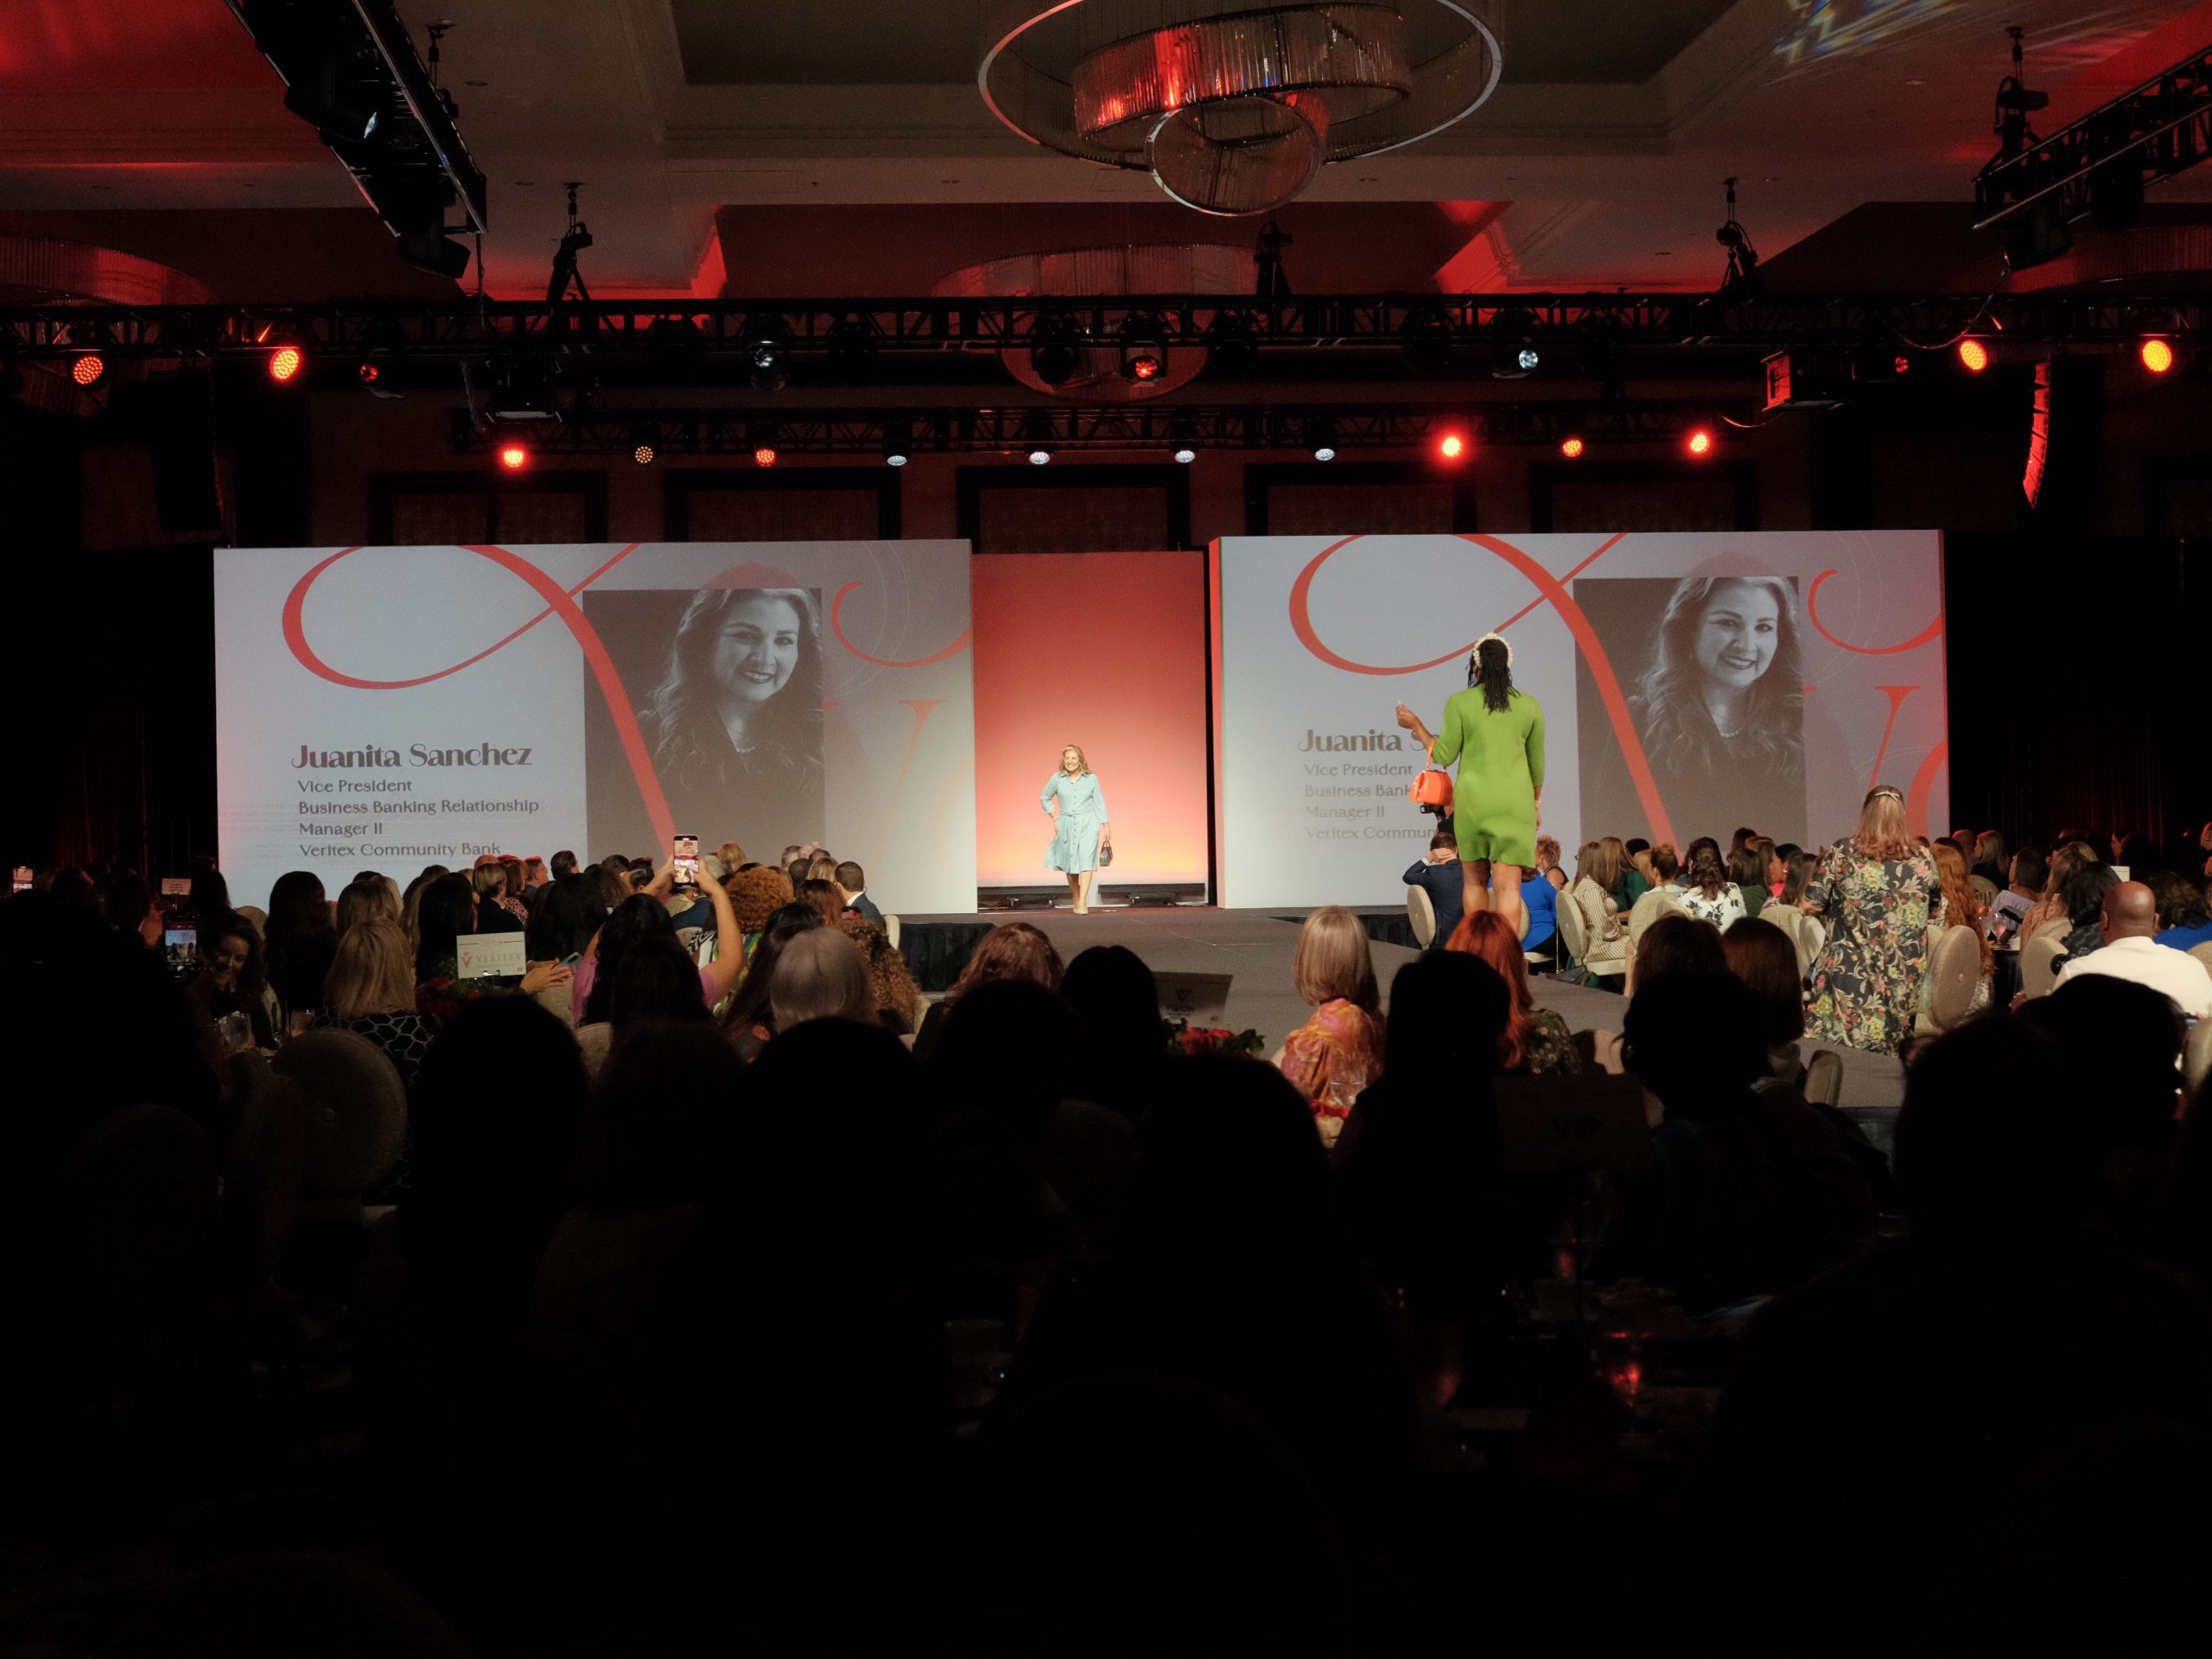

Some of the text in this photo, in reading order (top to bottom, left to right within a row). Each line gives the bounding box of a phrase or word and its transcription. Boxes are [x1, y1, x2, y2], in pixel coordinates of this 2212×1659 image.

[1298, 728, 1403, 752] Juanita
[291, 742, 532, 768] Juanita Sanchez
[1304, 764, 1413, 776] Vice President
[298, 779, 413, 792] Vice President
[1306, 785, 1410, 797] Business Bank
[299, 799, 539, 816] Business Banking Relationship
[1306, 805, 1384, 819] Manager II
[300, 823, 383, 838] Manager II
[1306, 826, 1435, 839] Veritex Commun
[300, 842, 500, 858] Veritex Community Bank
[476, 953, 521, 962] VERITEX
